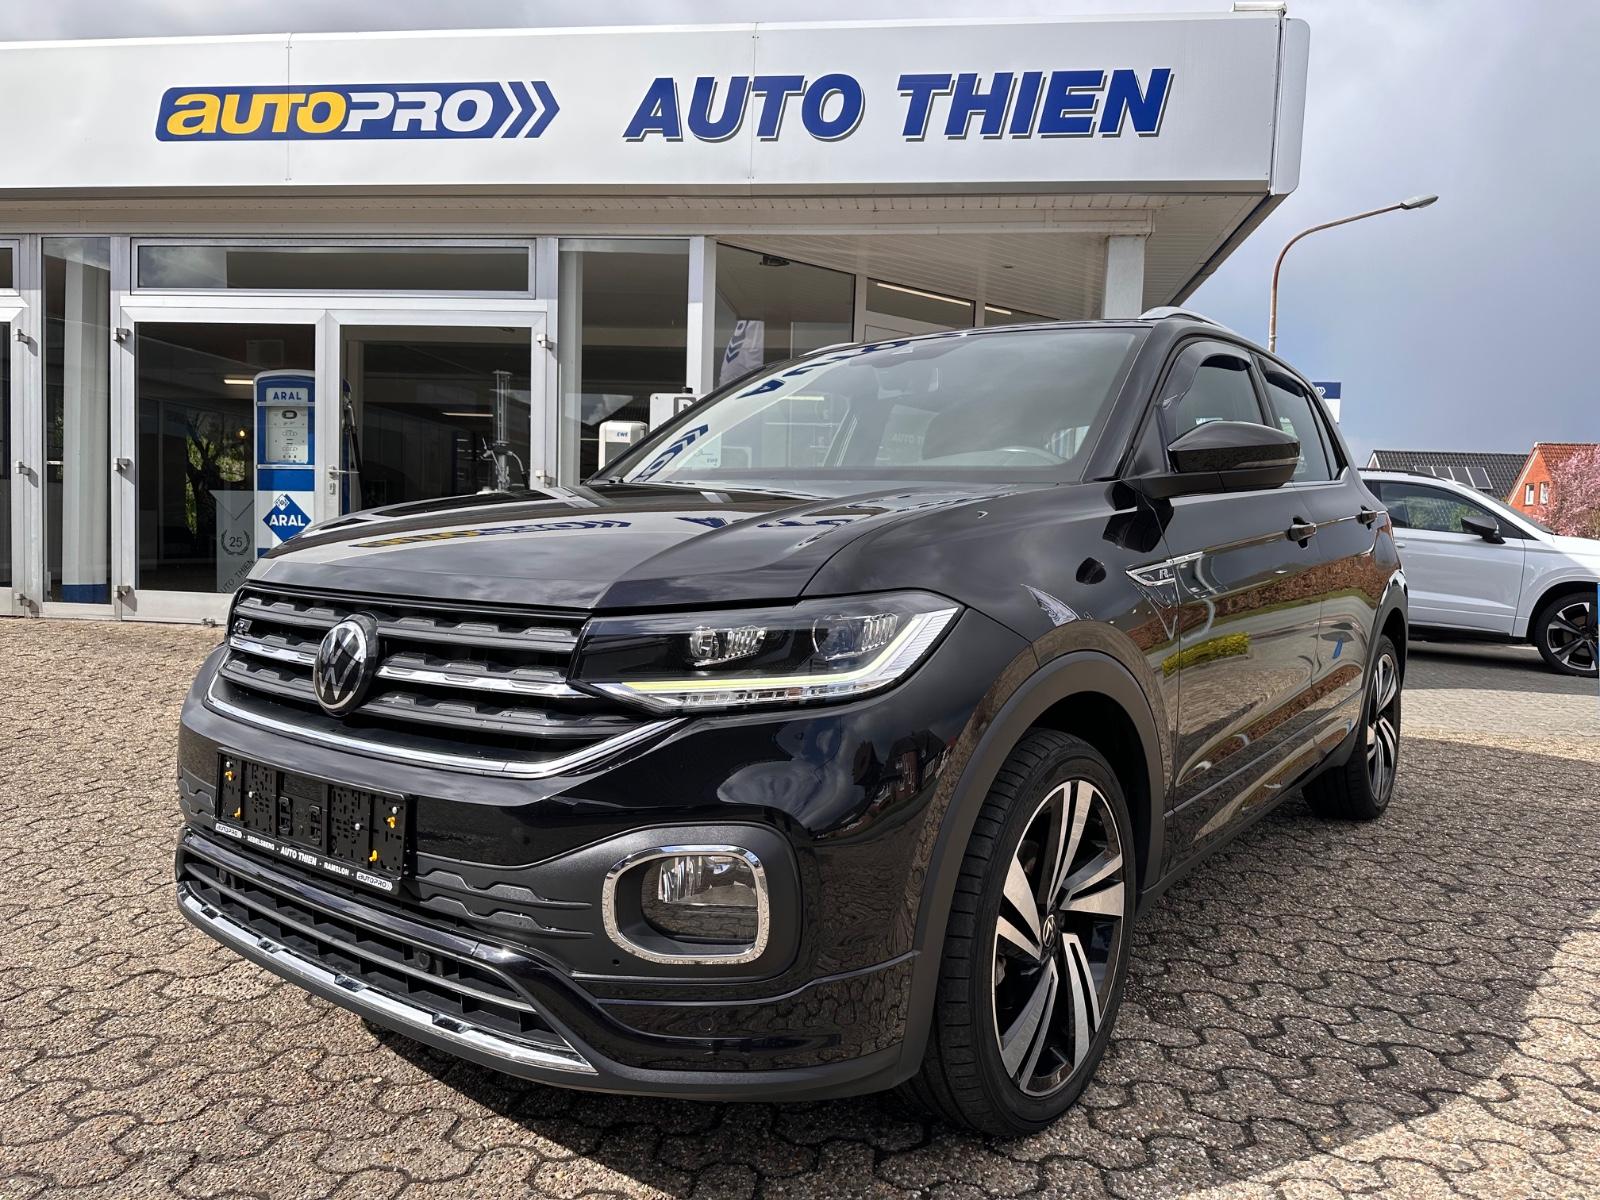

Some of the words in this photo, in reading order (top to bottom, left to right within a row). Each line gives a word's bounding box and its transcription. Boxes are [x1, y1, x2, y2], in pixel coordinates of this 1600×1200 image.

[622, 73, 866, 142] AUTO
[897, 68, 1174, 140] THIEN
[273, 391, 302, 401] ARAL
[269, 514, 306, 527] ARAL
[229, 536, 243, 548] 25
[280, 846, 298, 859] AUTO
[298, 852, 317, 866] THIEN
